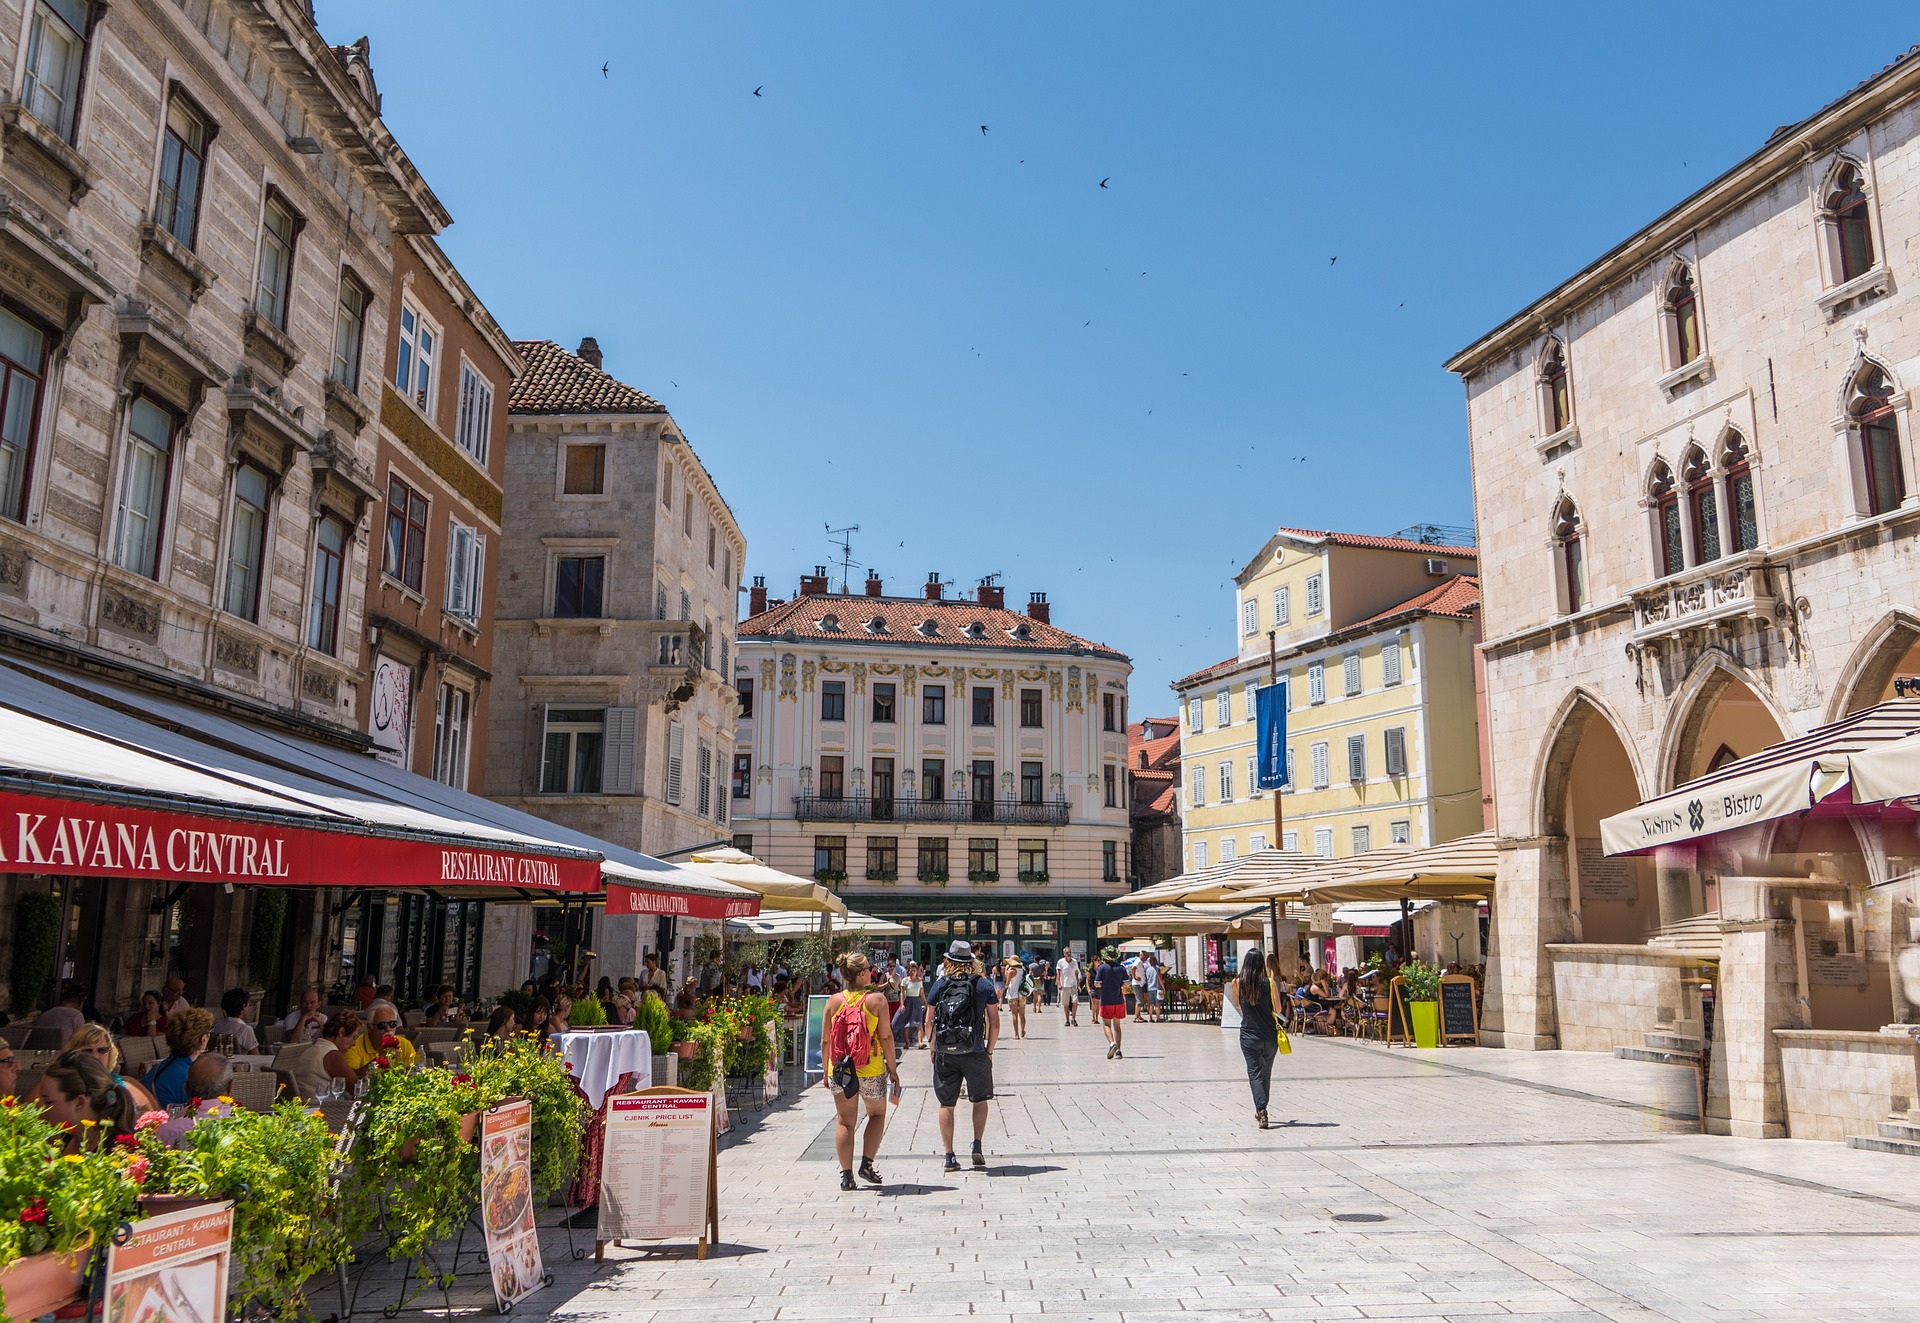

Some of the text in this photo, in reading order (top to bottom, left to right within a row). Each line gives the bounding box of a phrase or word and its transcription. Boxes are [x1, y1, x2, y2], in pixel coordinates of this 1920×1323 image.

[1724, 793, 1763, 819] Bistro
[15, 812, 160, 870] KAVANA
[166, 828, 289, 877] CENTRAL
[441, 850, 560, 886] RESTAURANT CENTRAL
[192, 1214, 228, 1232] KAVANA
[152, 1236, 197, 1257] CENTRAL
